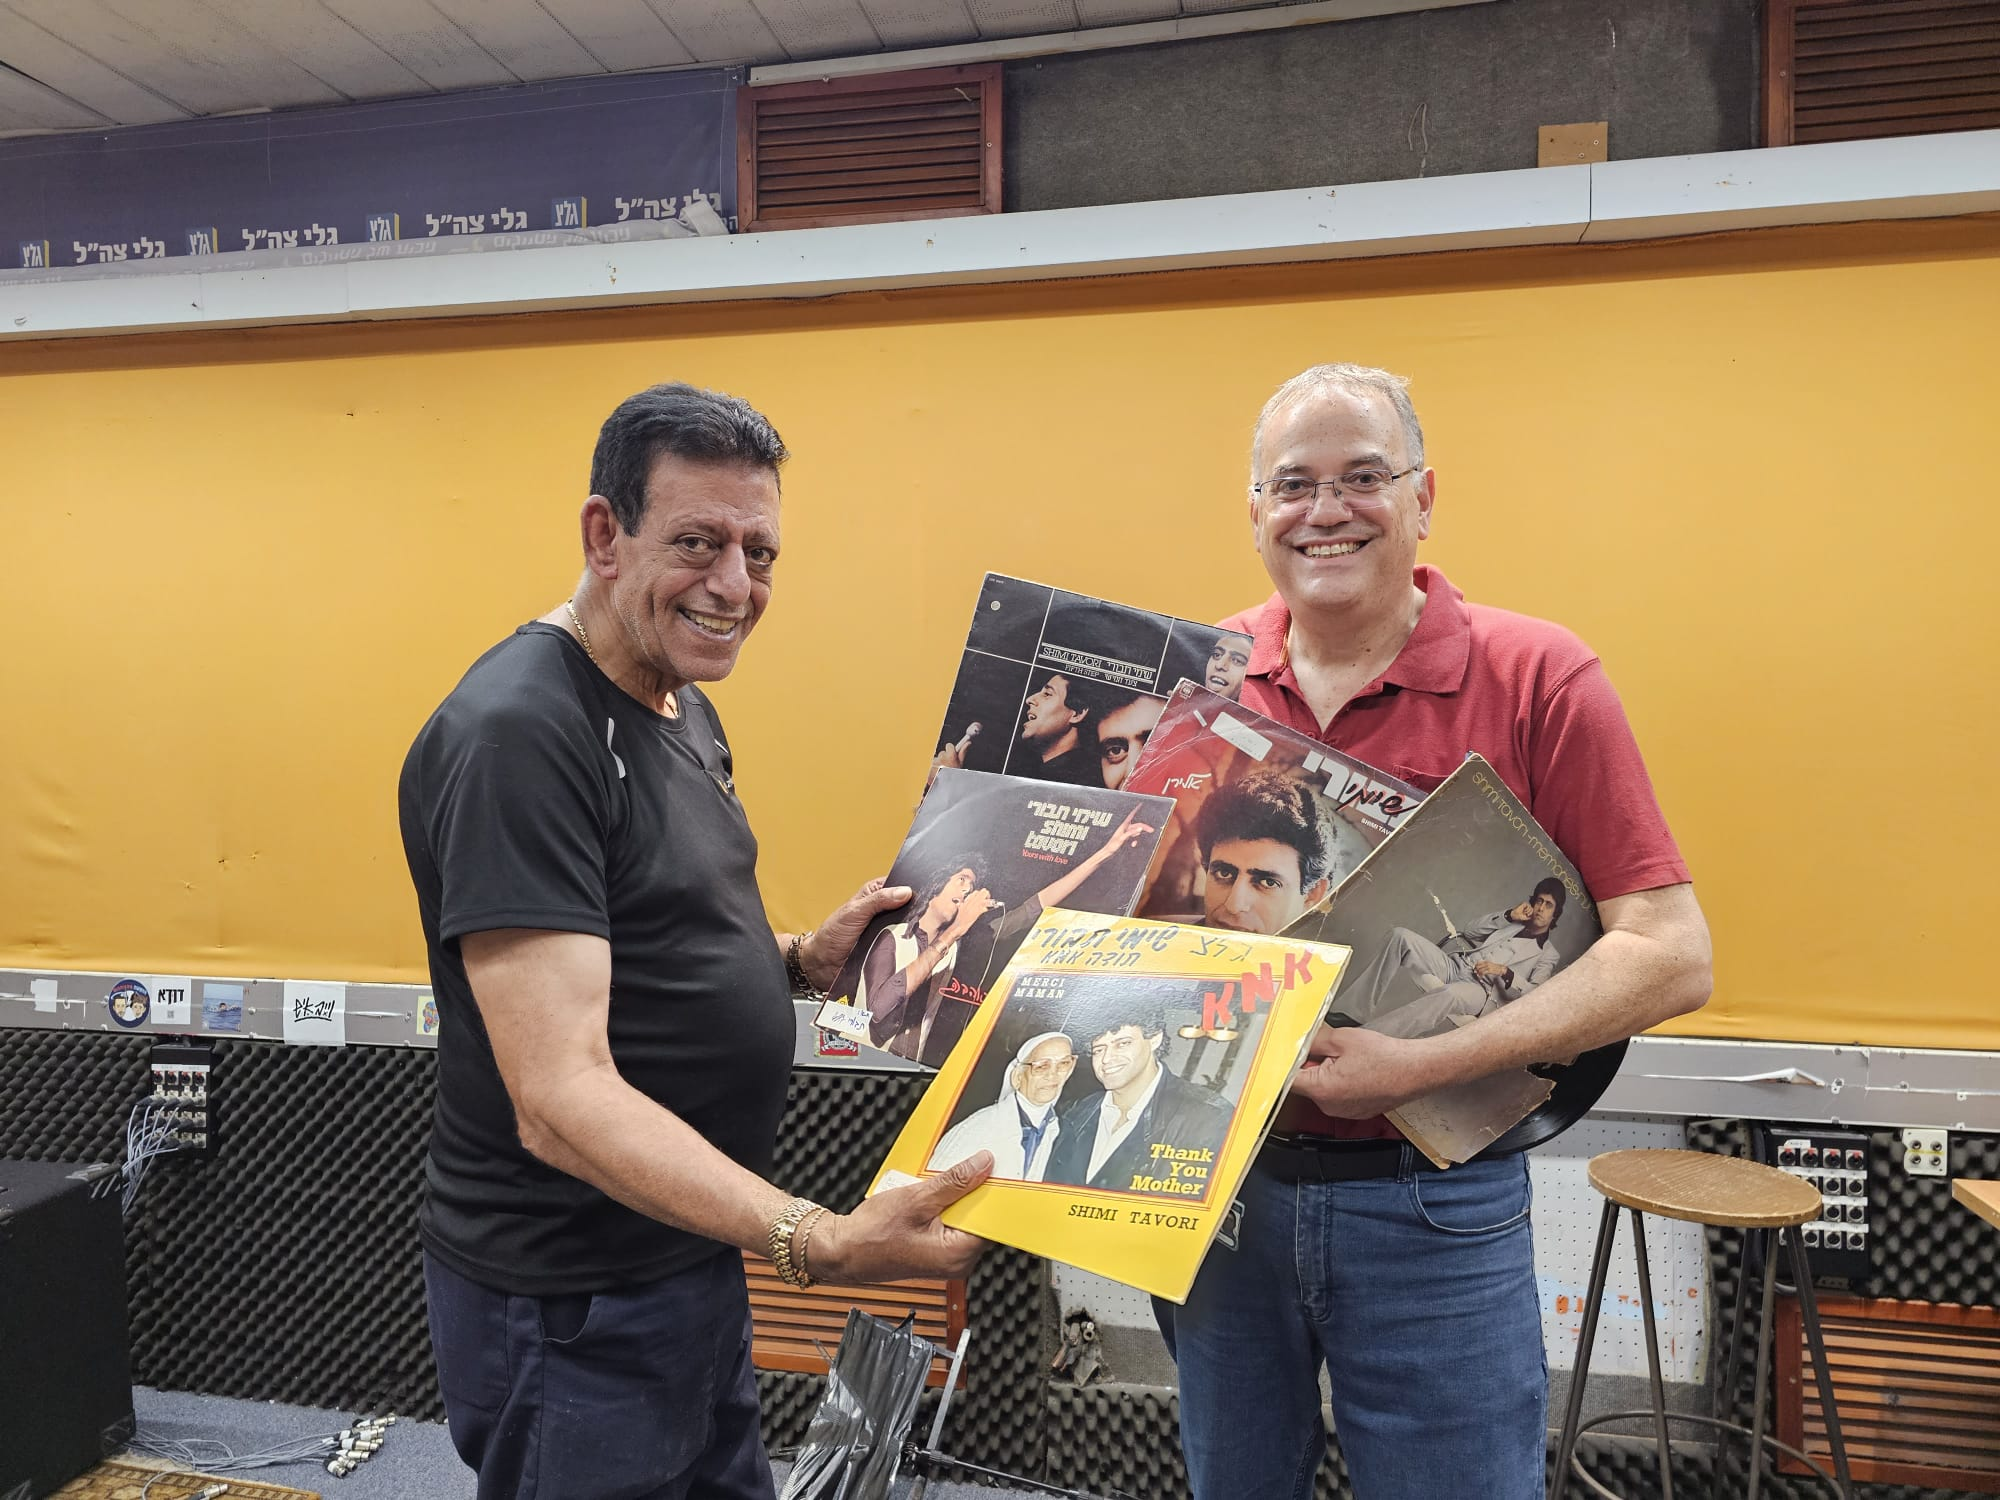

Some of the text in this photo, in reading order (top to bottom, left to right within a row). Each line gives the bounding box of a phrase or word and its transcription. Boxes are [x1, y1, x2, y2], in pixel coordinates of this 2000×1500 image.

[425, 207, 528, 237] גלי צה"ל
[242, 223, 339, 251] גלי צה"ל
[73, 236, 166, 264] גלי צה"ל
[1042, 647, 1102, 668] SHIMI TAVORI
[1064, 664, 1100, 678] FIFTH STEP
[1360, 817, 1378, 830] SHIMI
[1022, 849, 1069, 865] Yours with love
[1021, 977, 1066, 988] MERCI
[1014, 987, 1065, 999] MAMAN
[1150, 1143, 1214, 1162] Thank
[1170, 1161, 1208, 1178] You
[1129, 1174, 1205, 1195] Mother
[1067, 1204, 1200, 1231] SHIMI TAVORI
